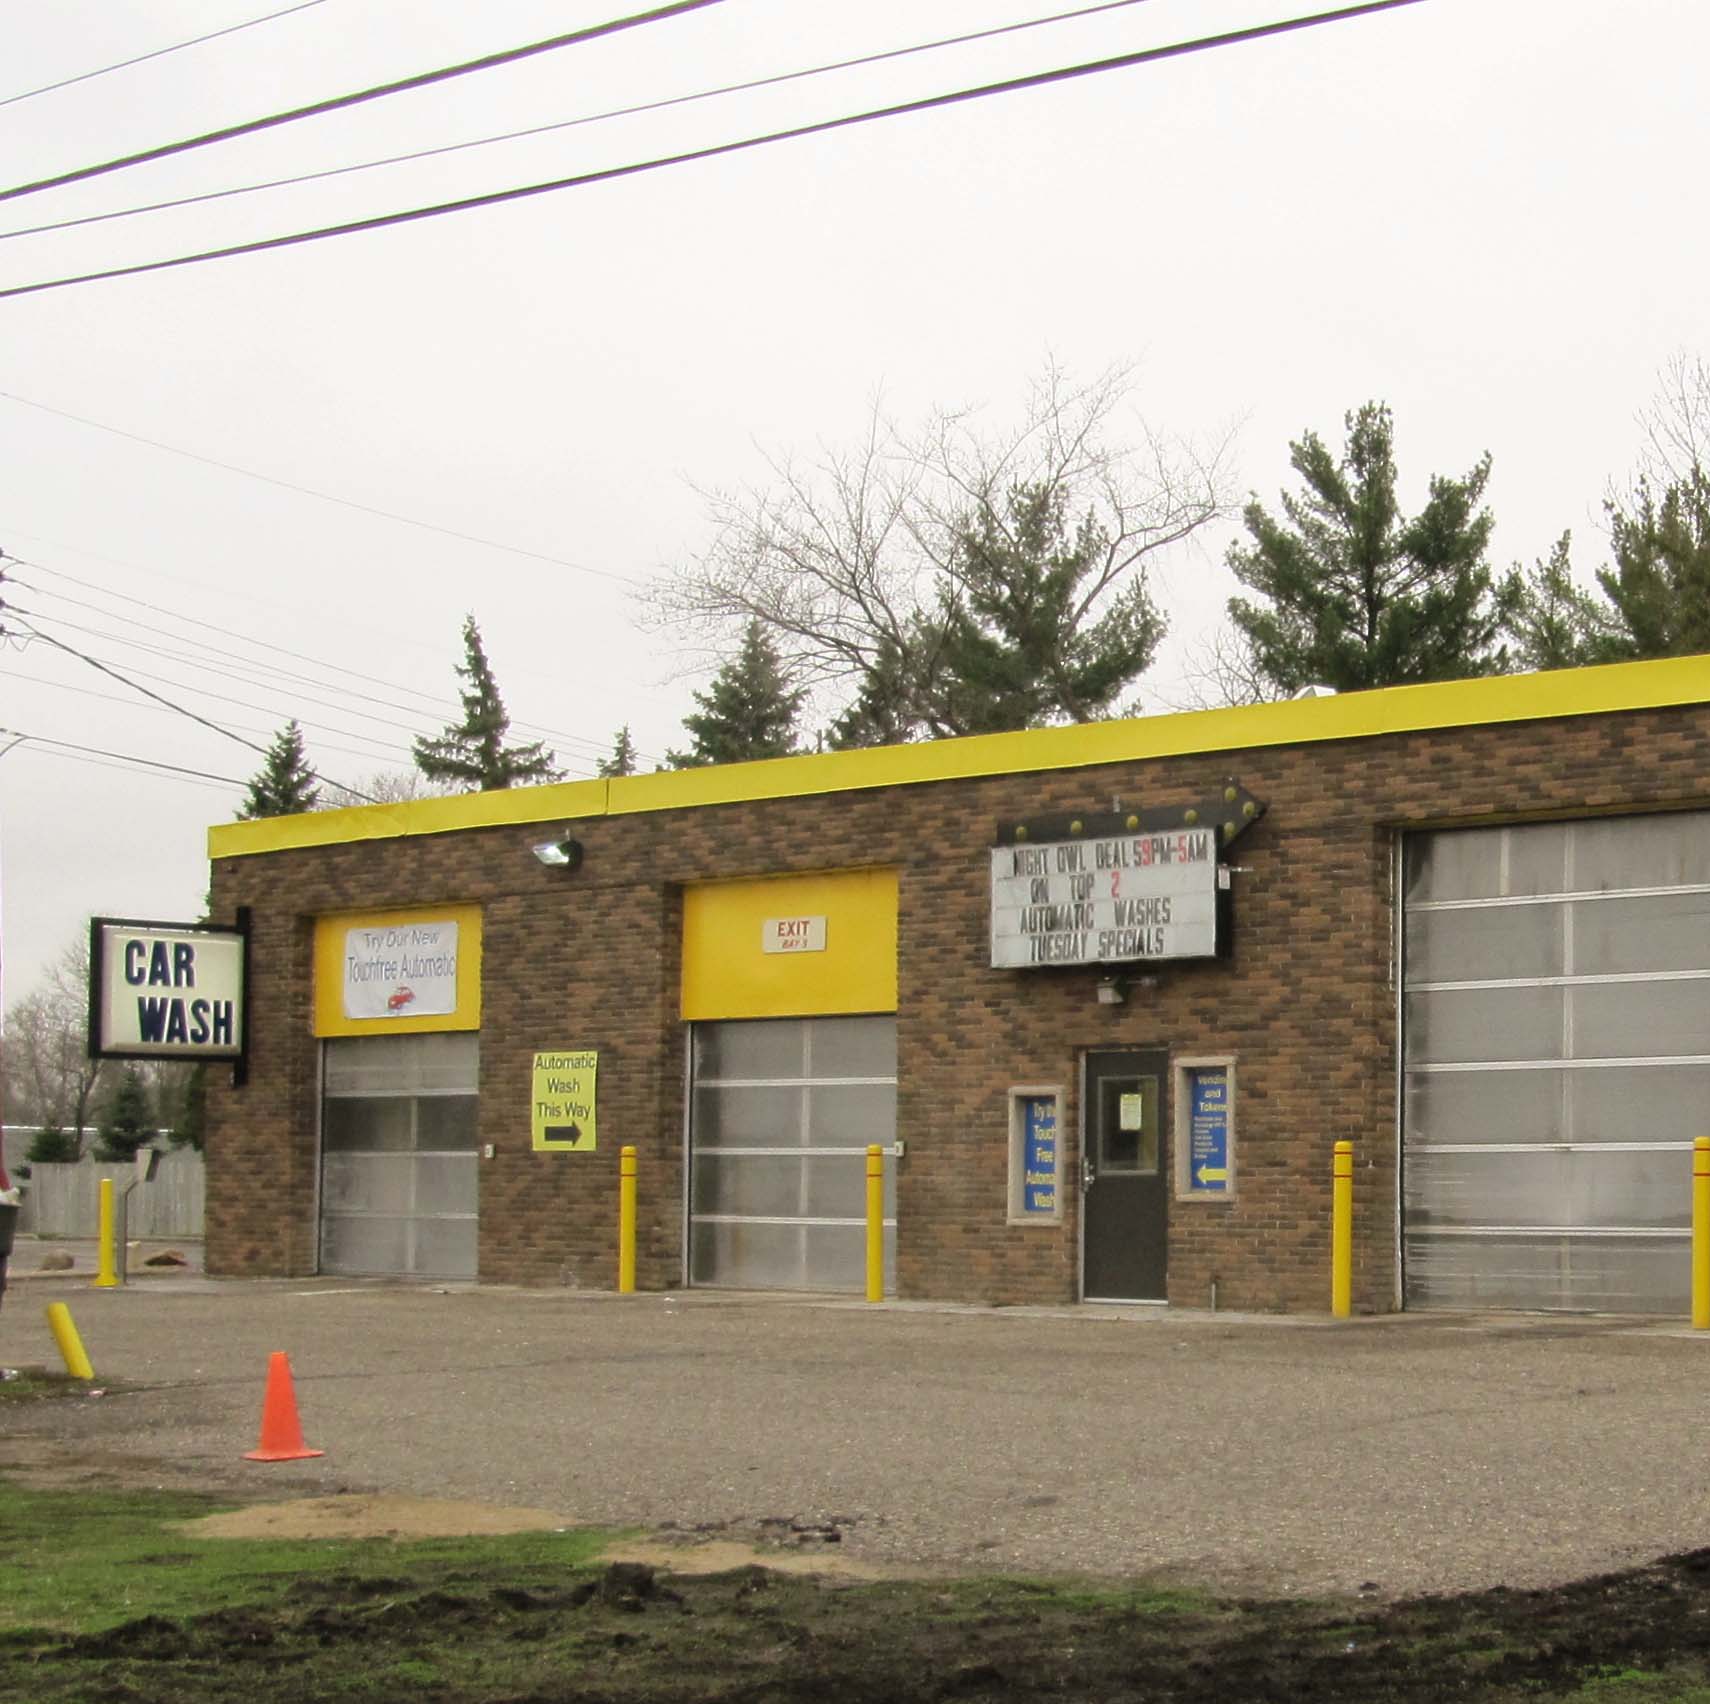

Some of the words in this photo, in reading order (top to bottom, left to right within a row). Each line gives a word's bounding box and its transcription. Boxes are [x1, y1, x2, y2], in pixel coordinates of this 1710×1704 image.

[1013, 847, 1049, 877] NIGHT
[1057, 845, 1087, 873] OWL
[1030, 878, 1049, 903] ON
[1069, 873, 1095, 901] TOP
[1111, 871, 1120, 898] 2
[777, 920, 810, 937] EXIT
[1020, 903, 1095, 934] AUTOMATIC
[1114, 897, 1171, 927] WASHES
[364, 932, 384, 953] Try
[386, 929, 409, 948] Our
[412, 928, 440, 945] New
[1029, 933, 1088, 962] TUESDAY
[1097, 928, 1164, 959] SPECIALS
[125, 939, 195, 987] CAR
[347, 955, 398, 983] Touchfree
[400, 953, 456, 979] Automatic
[138, 996, 232, 1045] WASH
[535, 1054, 596, 1070] Automatic
[547, 1078, 580, 1094] Wash
[1198, 1075, 1227, 1085] Vendin
[1204, 1088, 1221, 1098] and
[536, 1102, 562, 1118] This
[564, 1101, 591, 1121] Way
